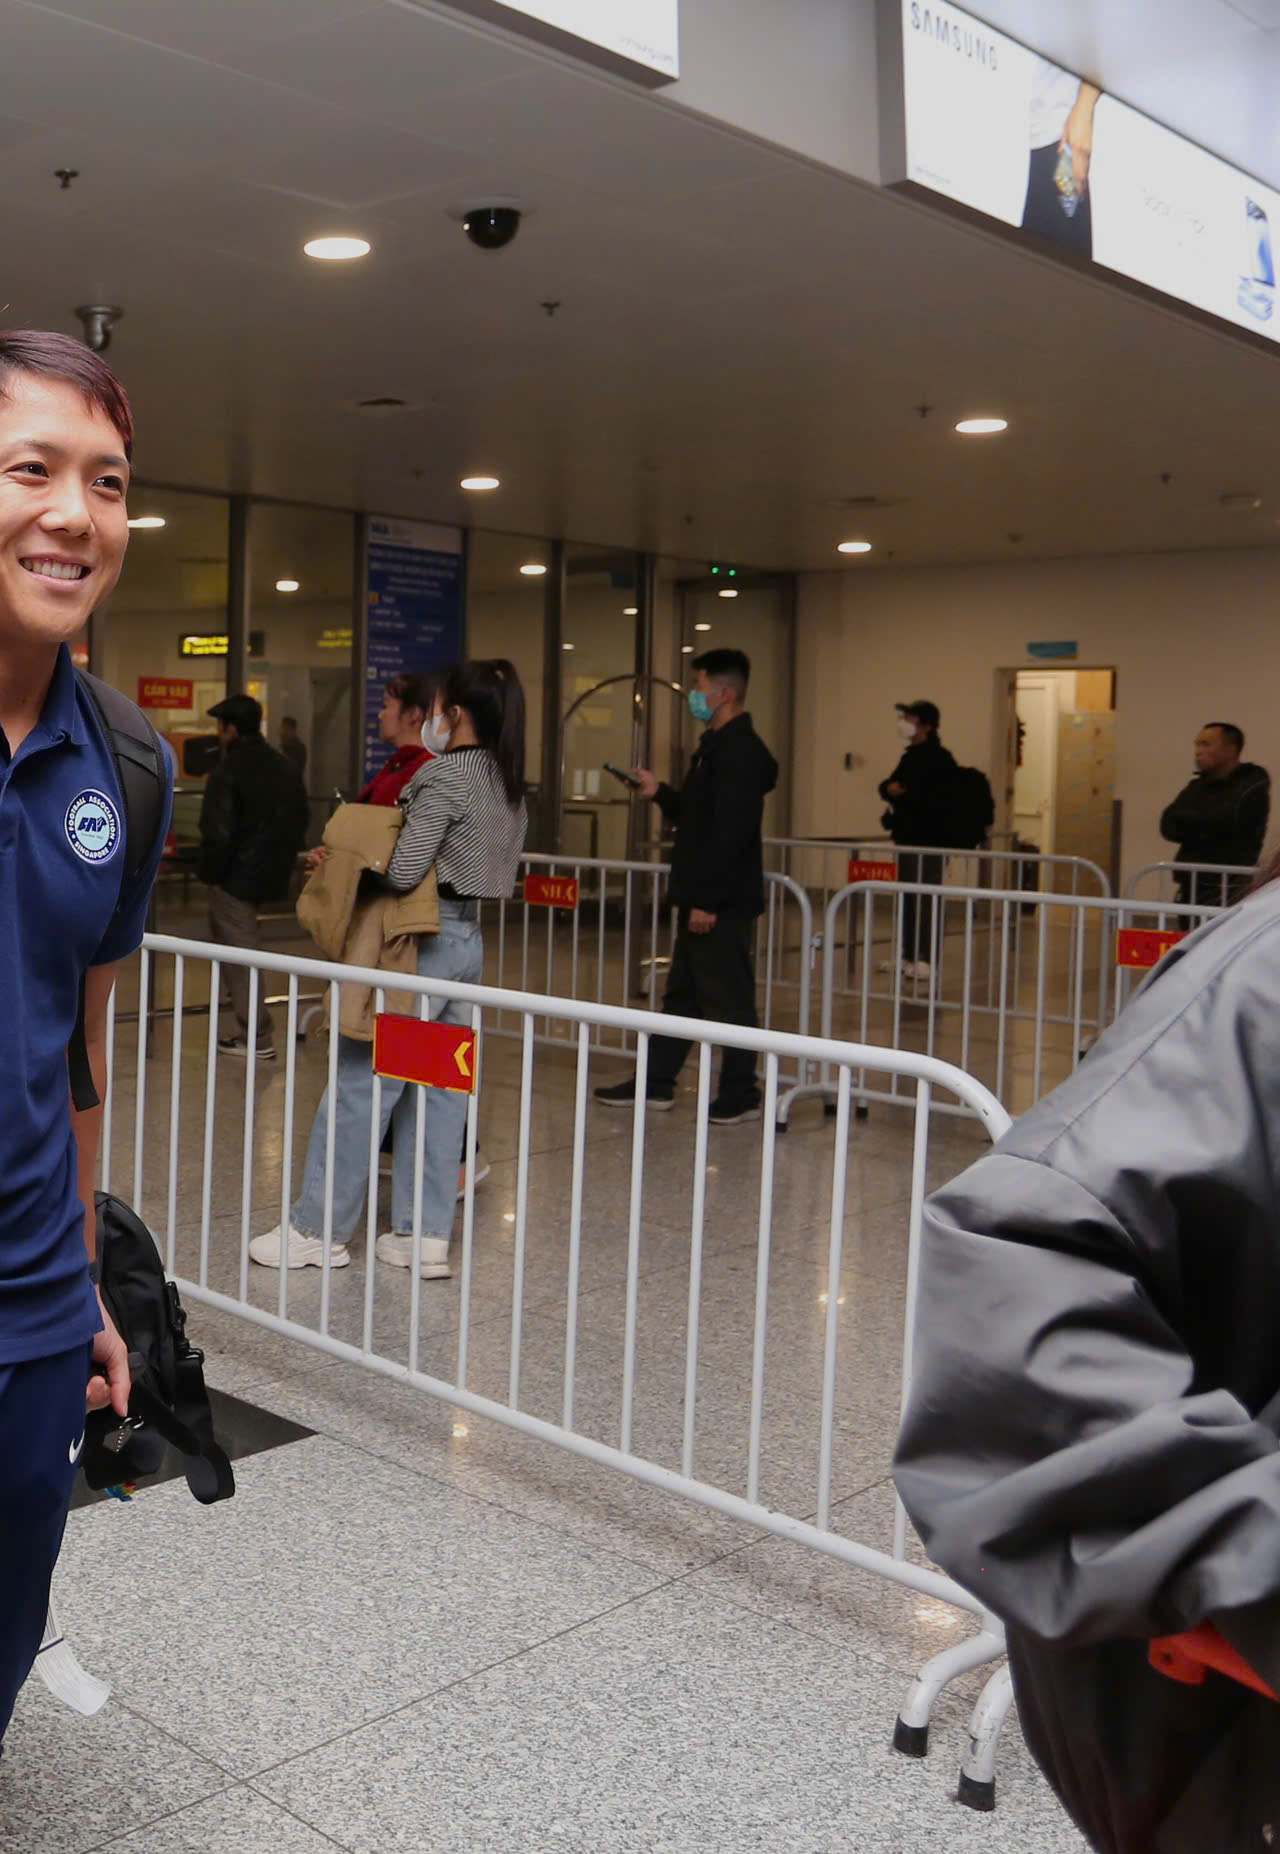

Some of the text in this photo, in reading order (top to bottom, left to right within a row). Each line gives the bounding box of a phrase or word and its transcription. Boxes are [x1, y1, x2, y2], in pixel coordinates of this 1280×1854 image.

[911, 1, 998, 71] SAMSUNG
[68, 795, 116, 841] FOOTBALL ASSOCIATION
[74, 841, 110, 859] SINGAPORE
